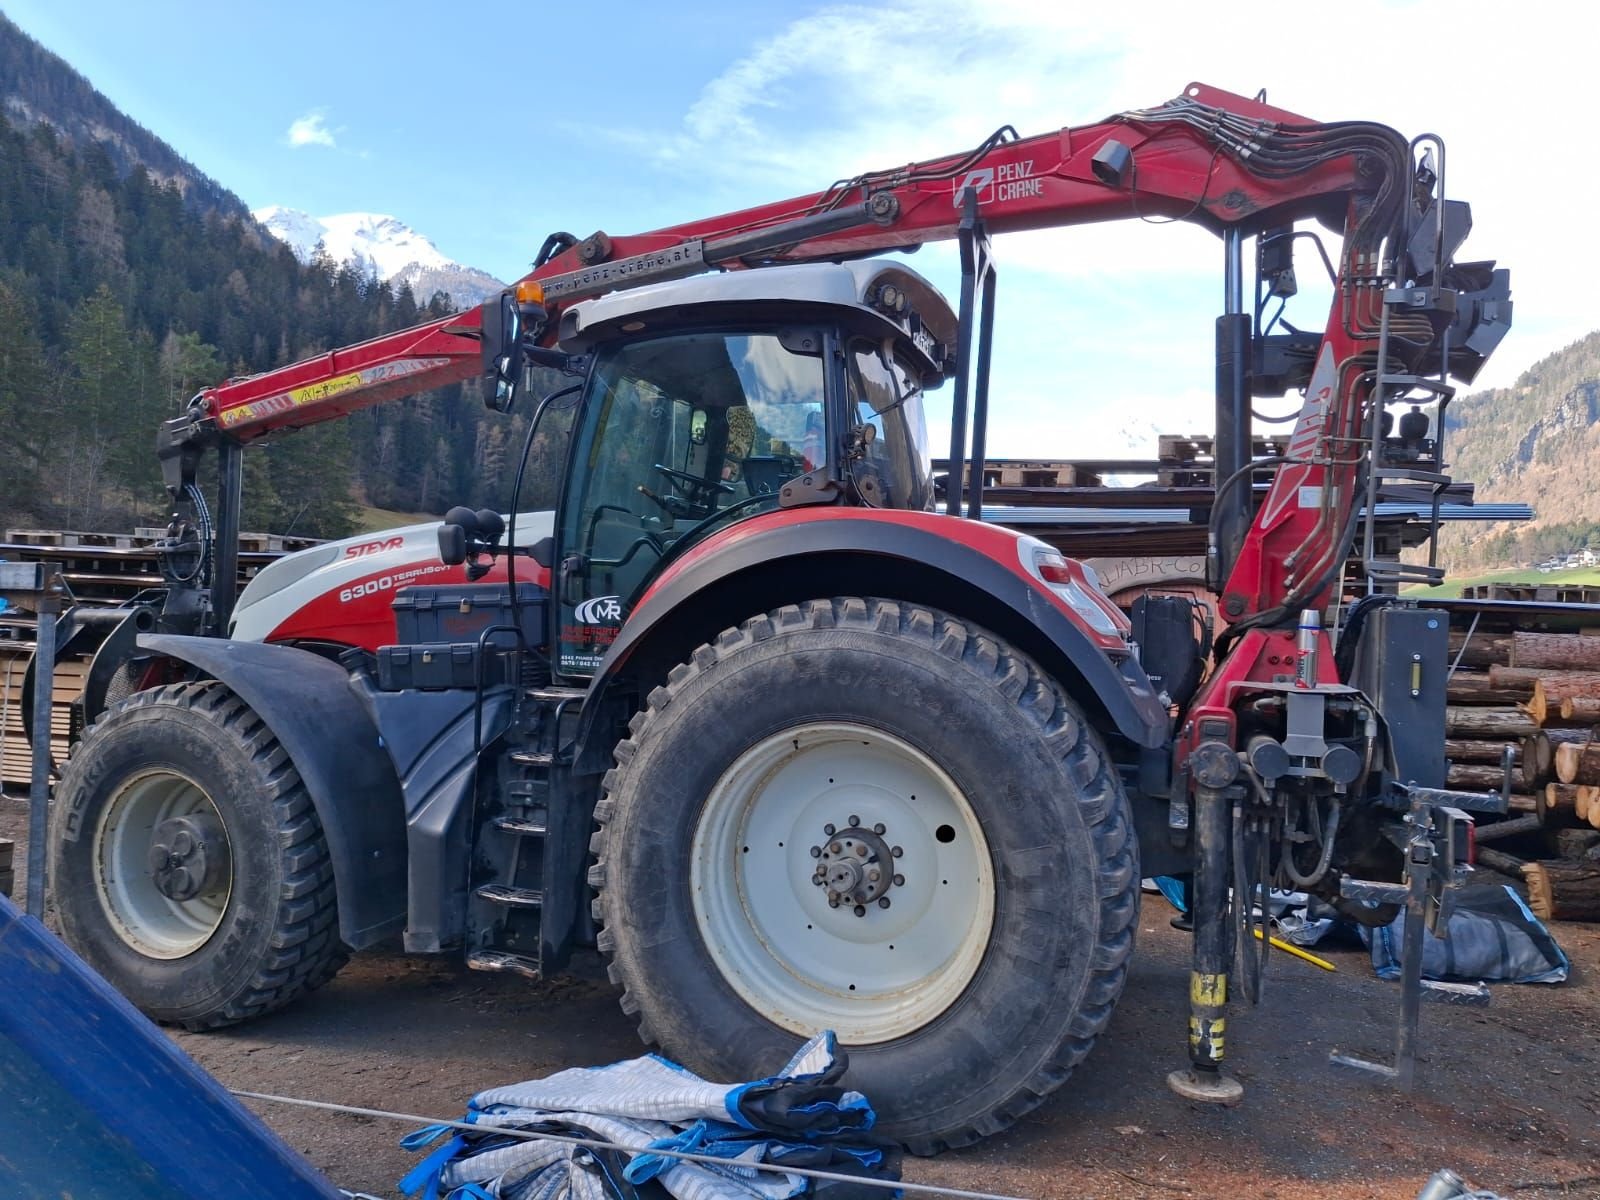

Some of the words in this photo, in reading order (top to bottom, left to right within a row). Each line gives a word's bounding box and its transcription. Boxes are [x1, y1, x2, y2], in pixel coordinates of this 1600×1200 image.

[998, 159, 1034, 182] PENZ
[998, 178, 1044, 202] CRANE
[344, 537, 404, 560] STEYR
[340, 576, 393, 603] 6300
